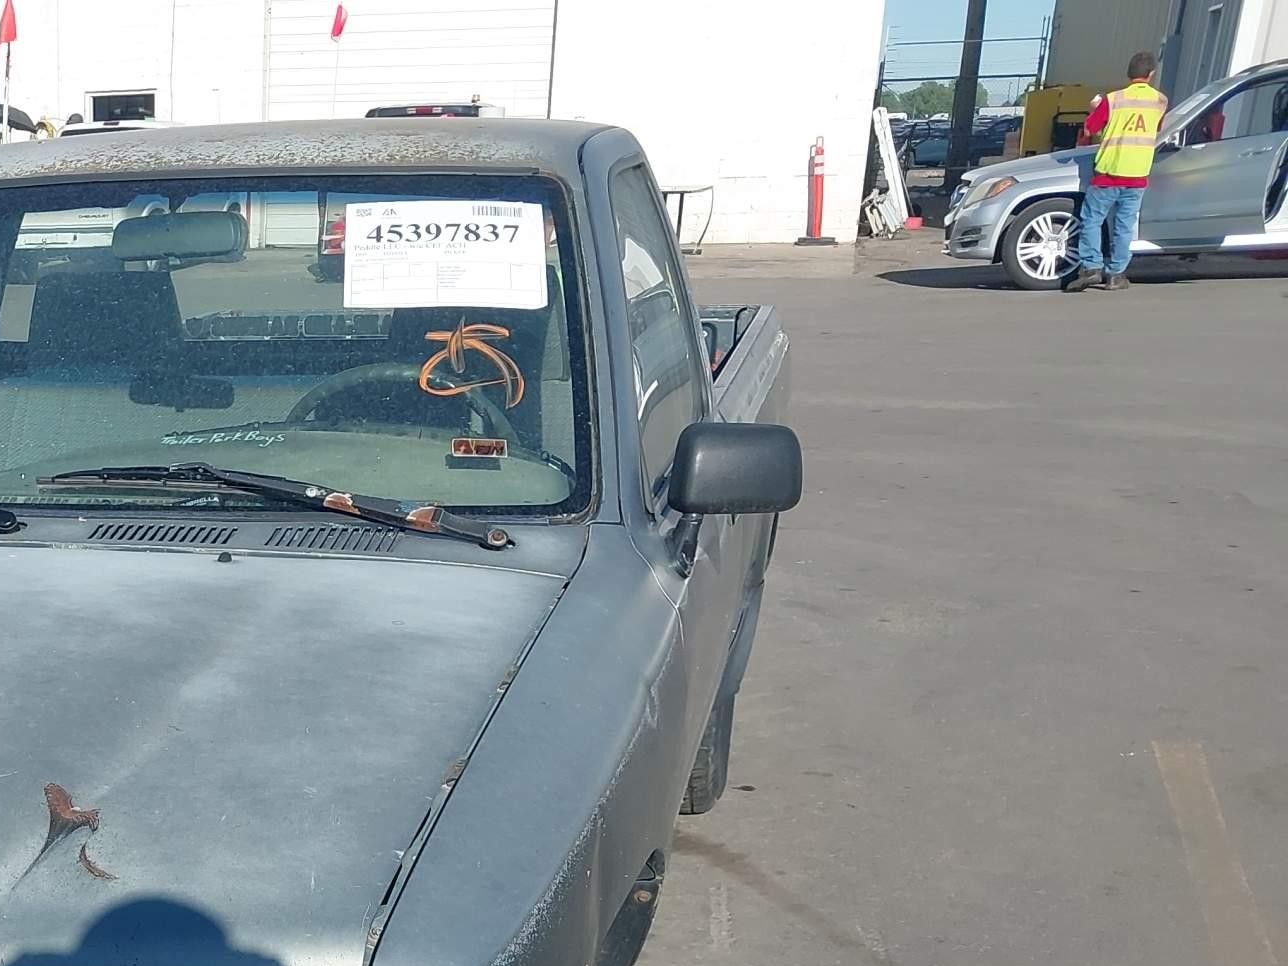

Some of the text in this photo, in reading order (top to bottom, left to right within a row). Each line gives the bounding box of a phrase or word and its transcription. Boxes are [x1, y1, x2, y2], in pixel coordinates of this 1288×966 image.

[366, 223, 520, 243] 45397837
[209, 430, 243, 444] Park
[244, 430, 286, 448] Boys
